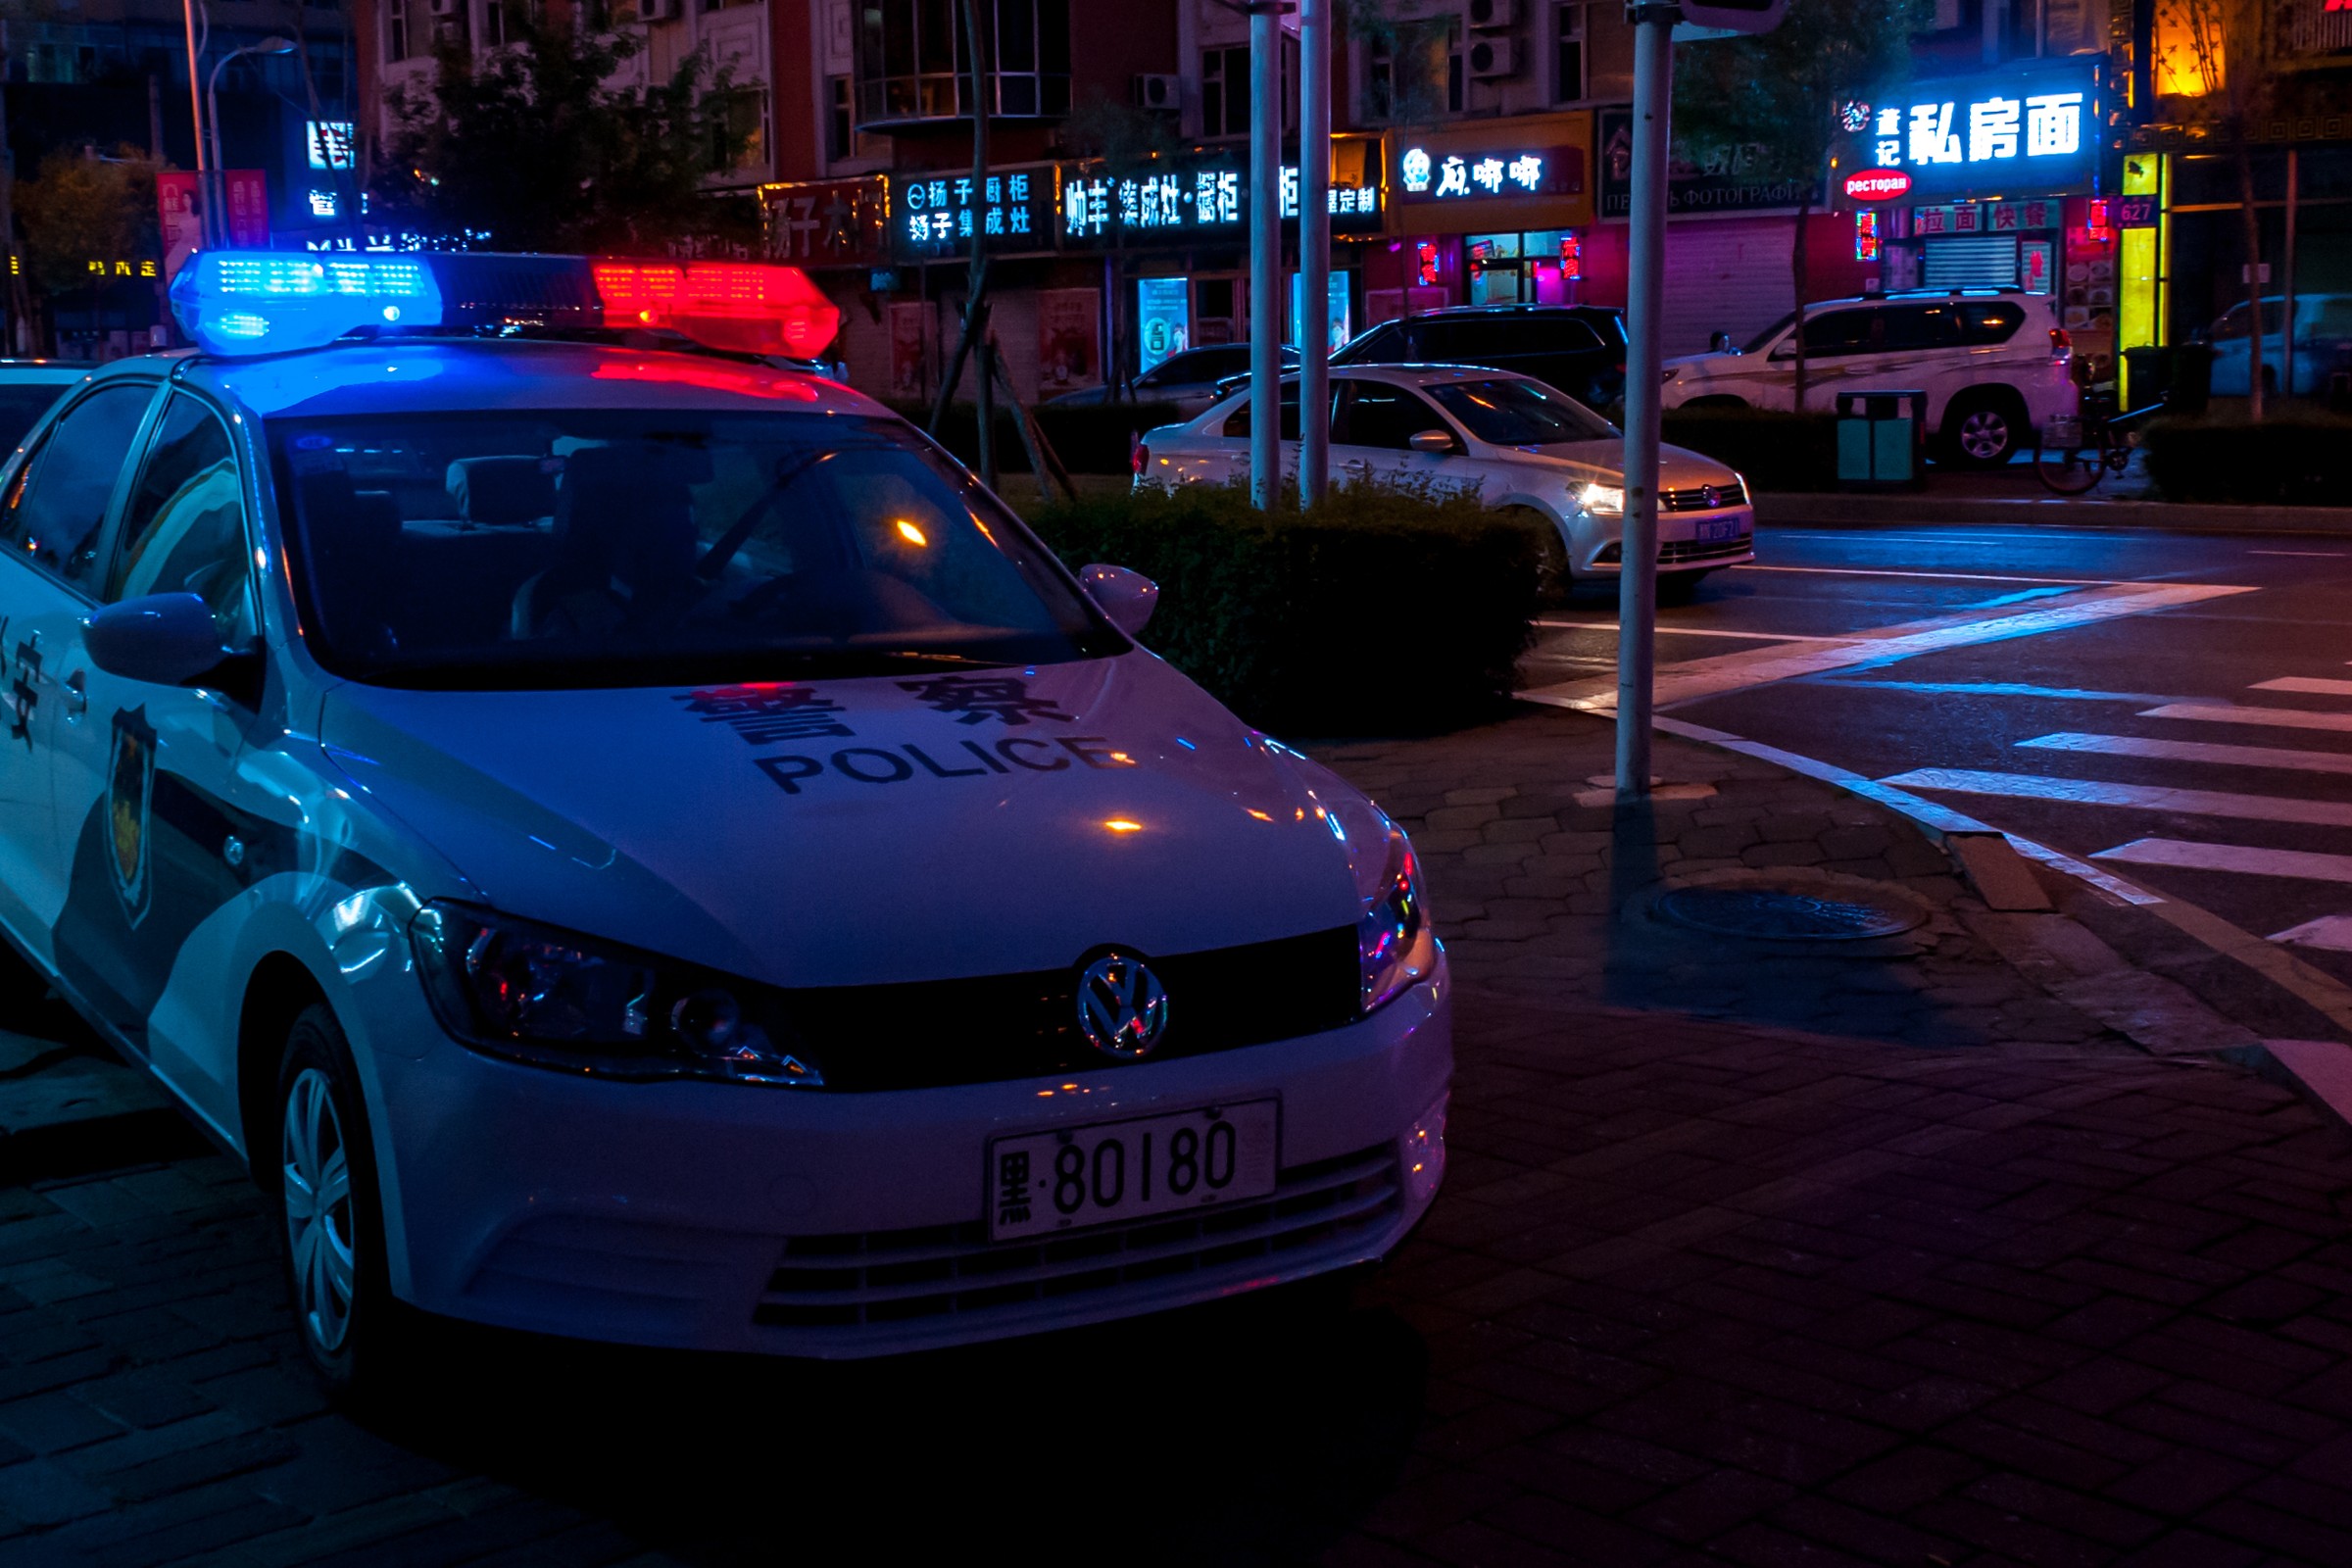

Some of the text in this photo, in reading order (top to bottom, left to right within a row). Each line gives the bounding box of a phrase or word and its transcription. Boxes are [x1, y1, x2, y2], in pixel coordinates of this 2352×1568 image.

[1908, 92, 2083, 166] 私房面
[1846, 176, 1907, 195] ресторан
[1924, 196, 2046, 232] 拉面 快餐
[2122, 203, 2151, 220] 627
[753, 736, 1141, 795] POLICE
